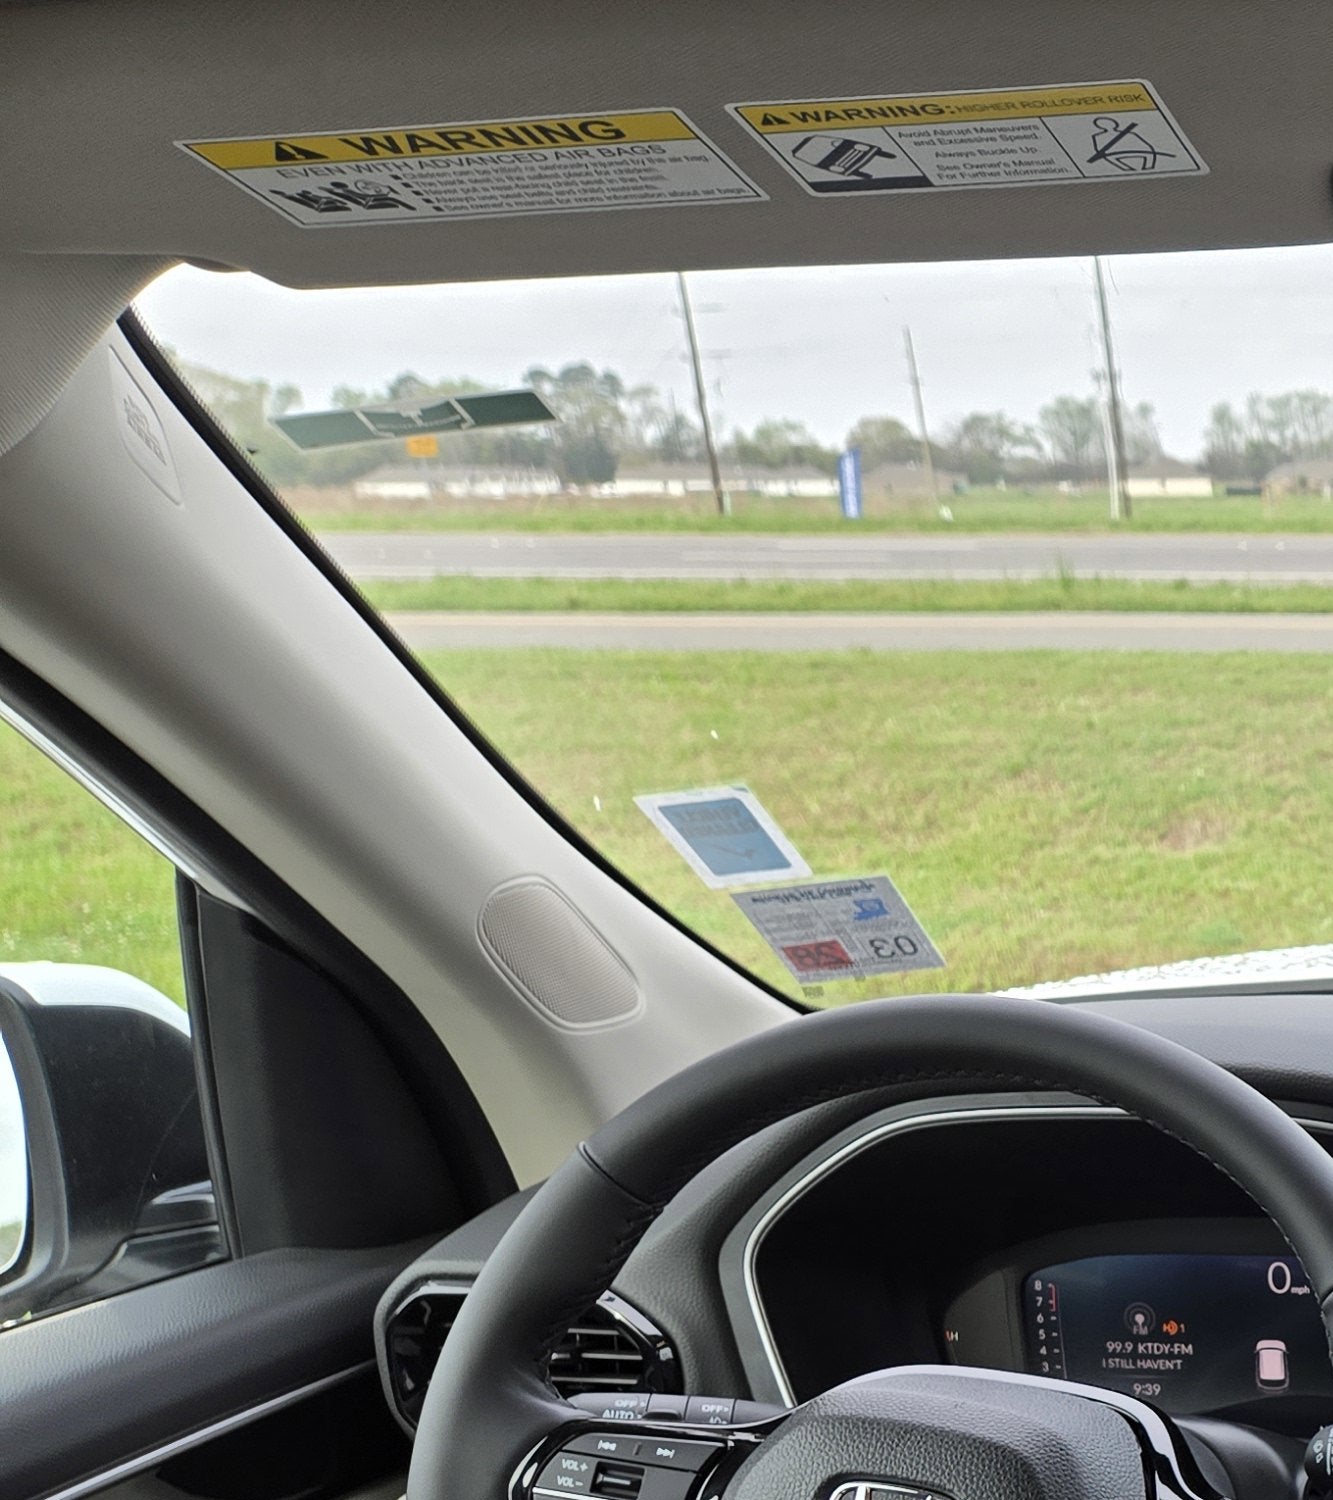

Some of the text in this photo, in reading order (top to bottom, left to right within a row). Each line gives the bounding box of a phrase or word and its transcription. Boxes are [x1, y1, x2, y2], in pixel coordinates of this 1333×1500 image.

[955, 92, 1145, 113] HIGHER ROLLOVER RISK
[790, 103, 955, 124] WARNING:
[338, 120, 627, 156] WARNING
[276, 144, 667, 179] EVEN WITH ADVANCED AIR BAGS
[1267, 1261, 1292, 1294] 0
[1034, 1280, 1042, 1292] 8
[1036, 1296, 1043, 1308] 7
[1036, 1313, 1045, 1324] 6
[1039, 1329, 1046, 1340] 5
[1039, 1346, 1047, 1356] 4
[1106, 1341, 1193, 1355] 99.9 KTDY-FM
[1107, 1359, 1136, 1370] STILL
[1138, 1359, 1183, 1370] HAVEN'T
[1132, 1383, 1161, 1396] 9:39
[701, 1404, 723, 1414] OFF
